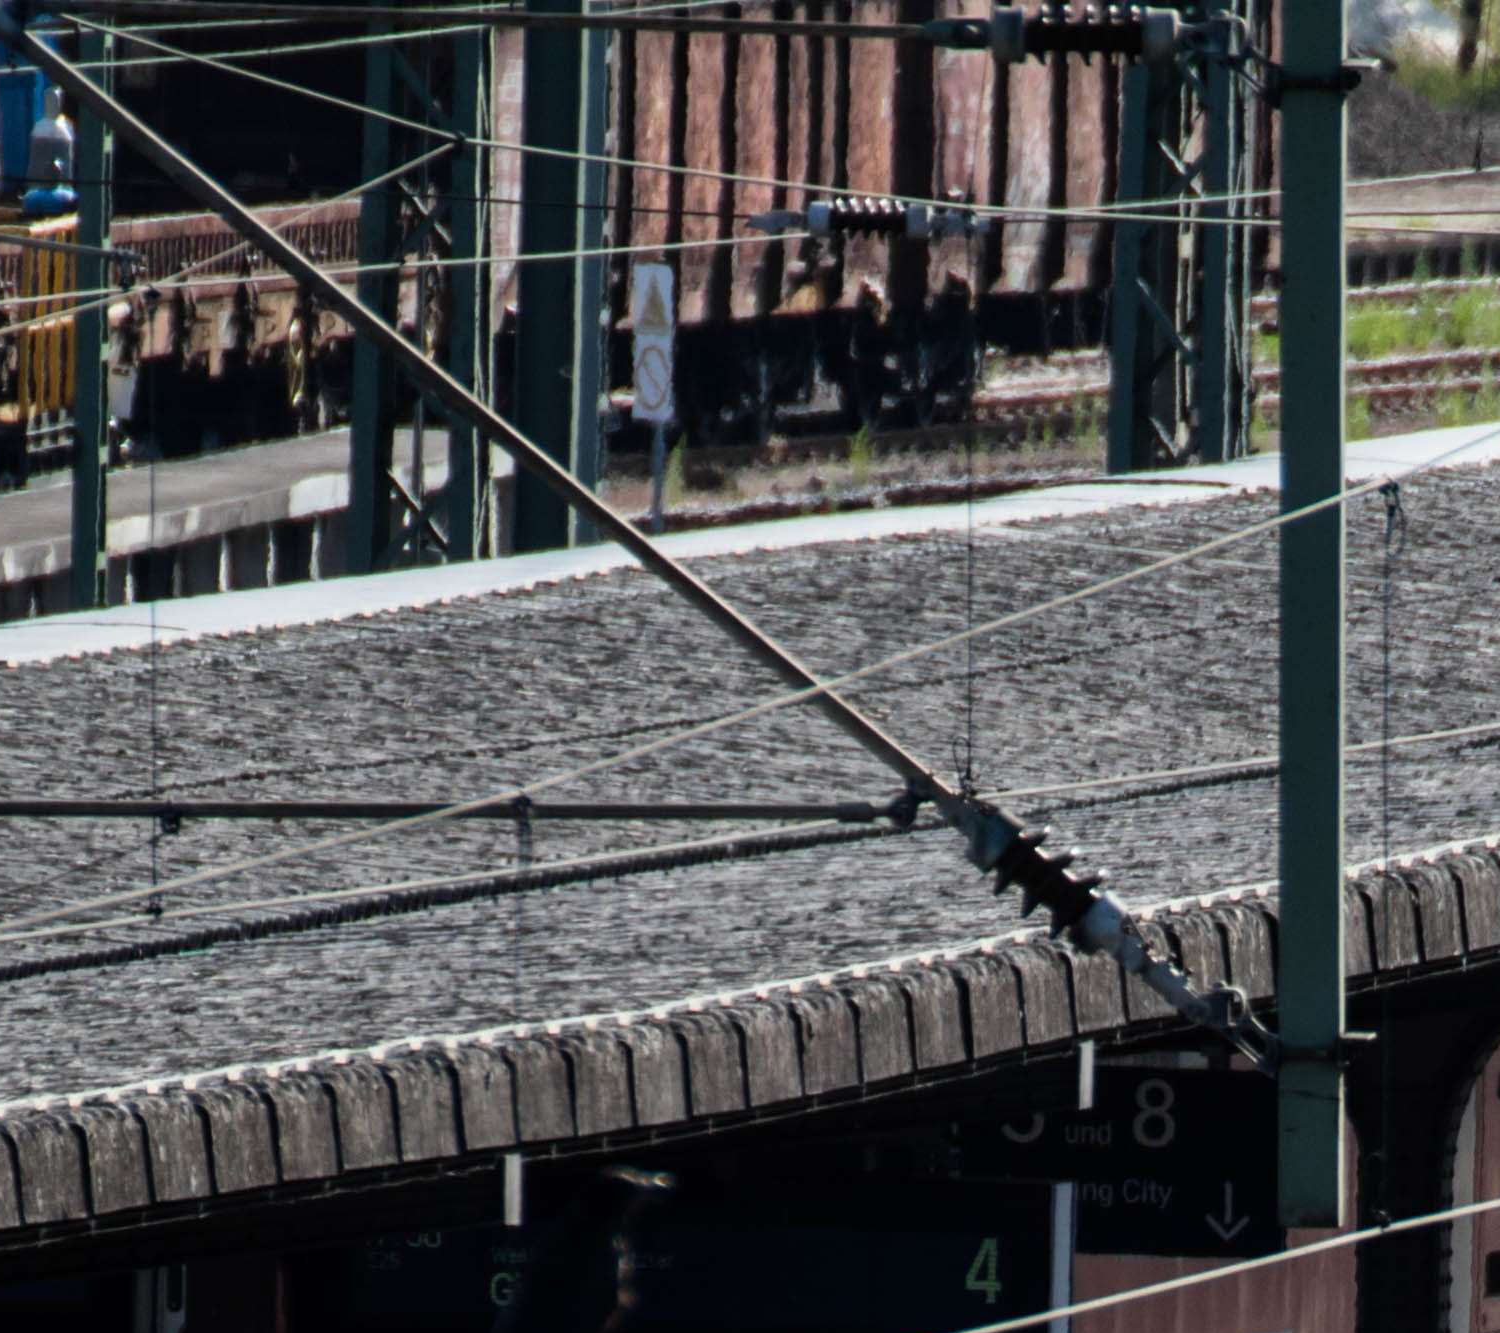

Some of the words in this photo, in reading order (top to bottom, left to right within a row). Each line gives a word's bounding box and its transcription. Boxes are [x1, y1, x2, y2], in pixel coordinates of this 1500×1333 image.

[1063, 1123, 1113, 1144] und
[1133, 1078, 1176, 1148] 8
[1122, 1177, 1173, 1209] City
[965, 1238, 1002, 1304] 4
